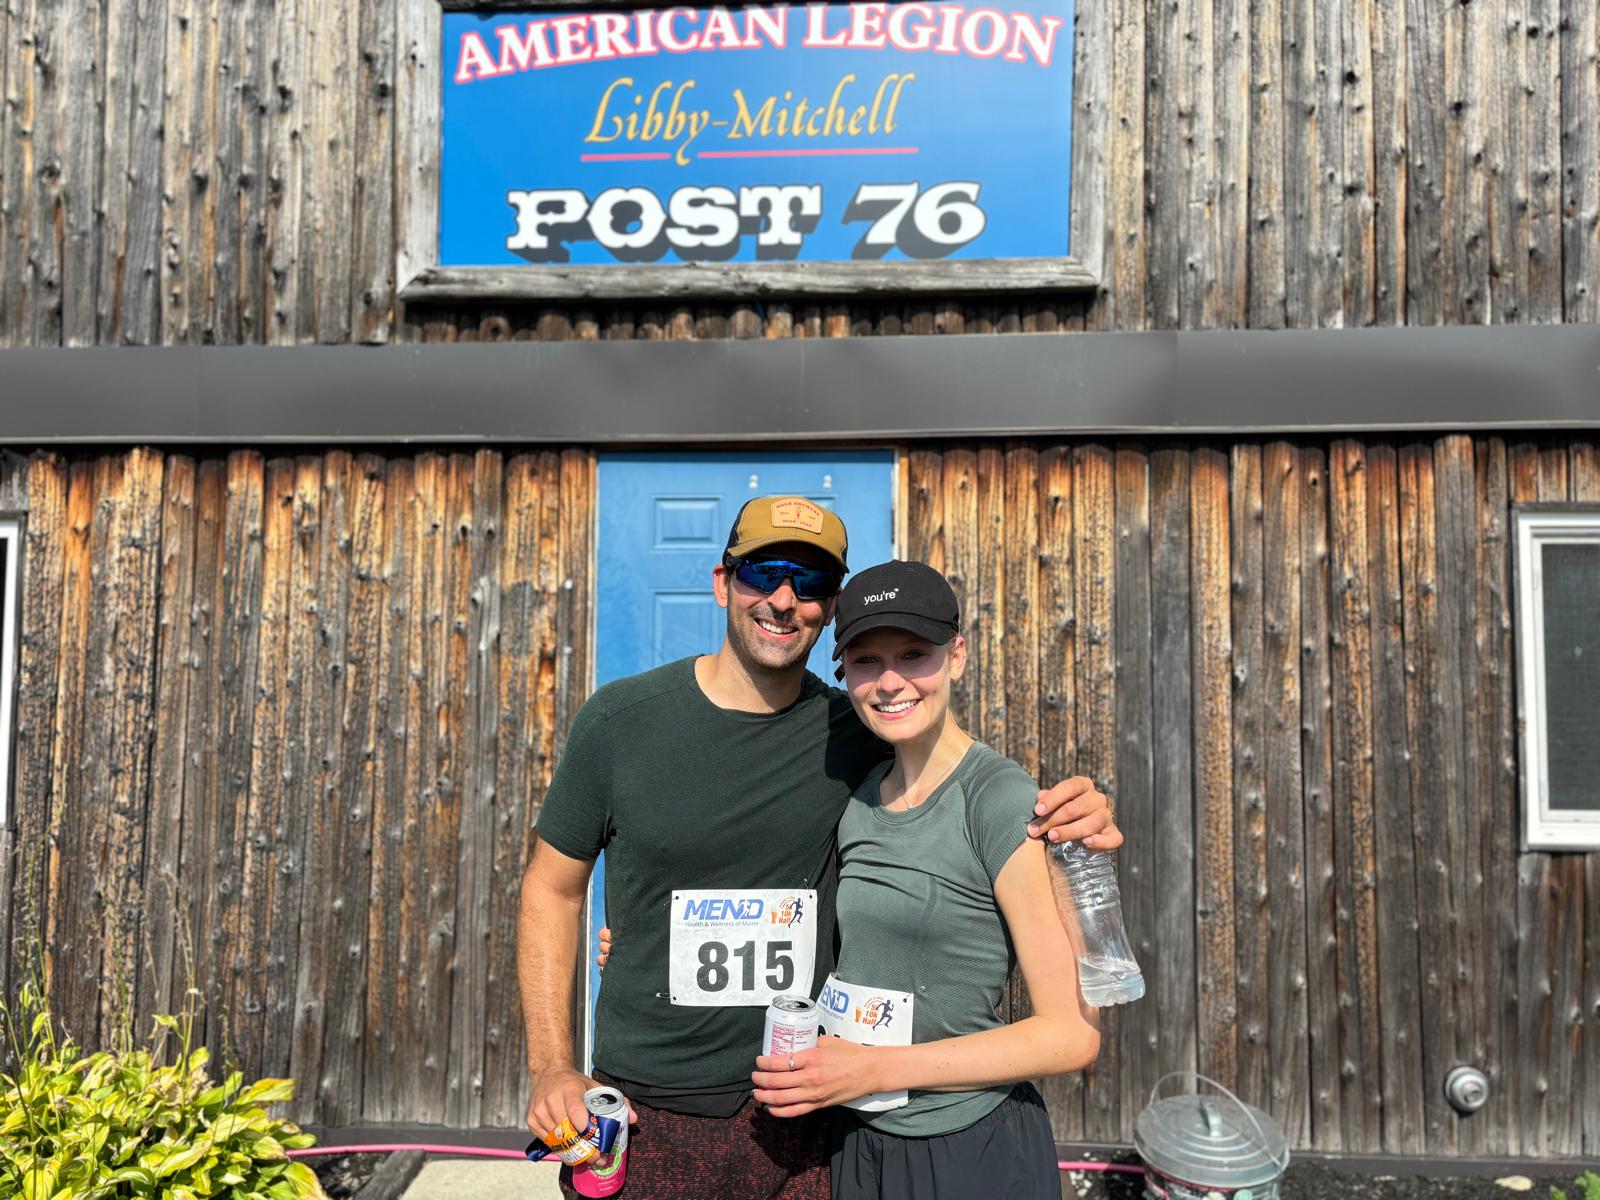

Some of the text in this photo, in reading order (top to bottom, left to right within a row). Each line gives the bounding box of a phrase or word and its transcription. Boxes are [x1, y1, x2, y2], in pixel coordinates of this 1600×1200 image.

[455, 2, 1063, 83] AMERICAN LEGION
[585, 73, 916, 166] Libby-Mitchell
[506, 180, 988, 256] POST 76
[683, 899, 765, 920] MEND
[696, 940, 795, 992] 815
[862, 1017, 877, 1025] Half
